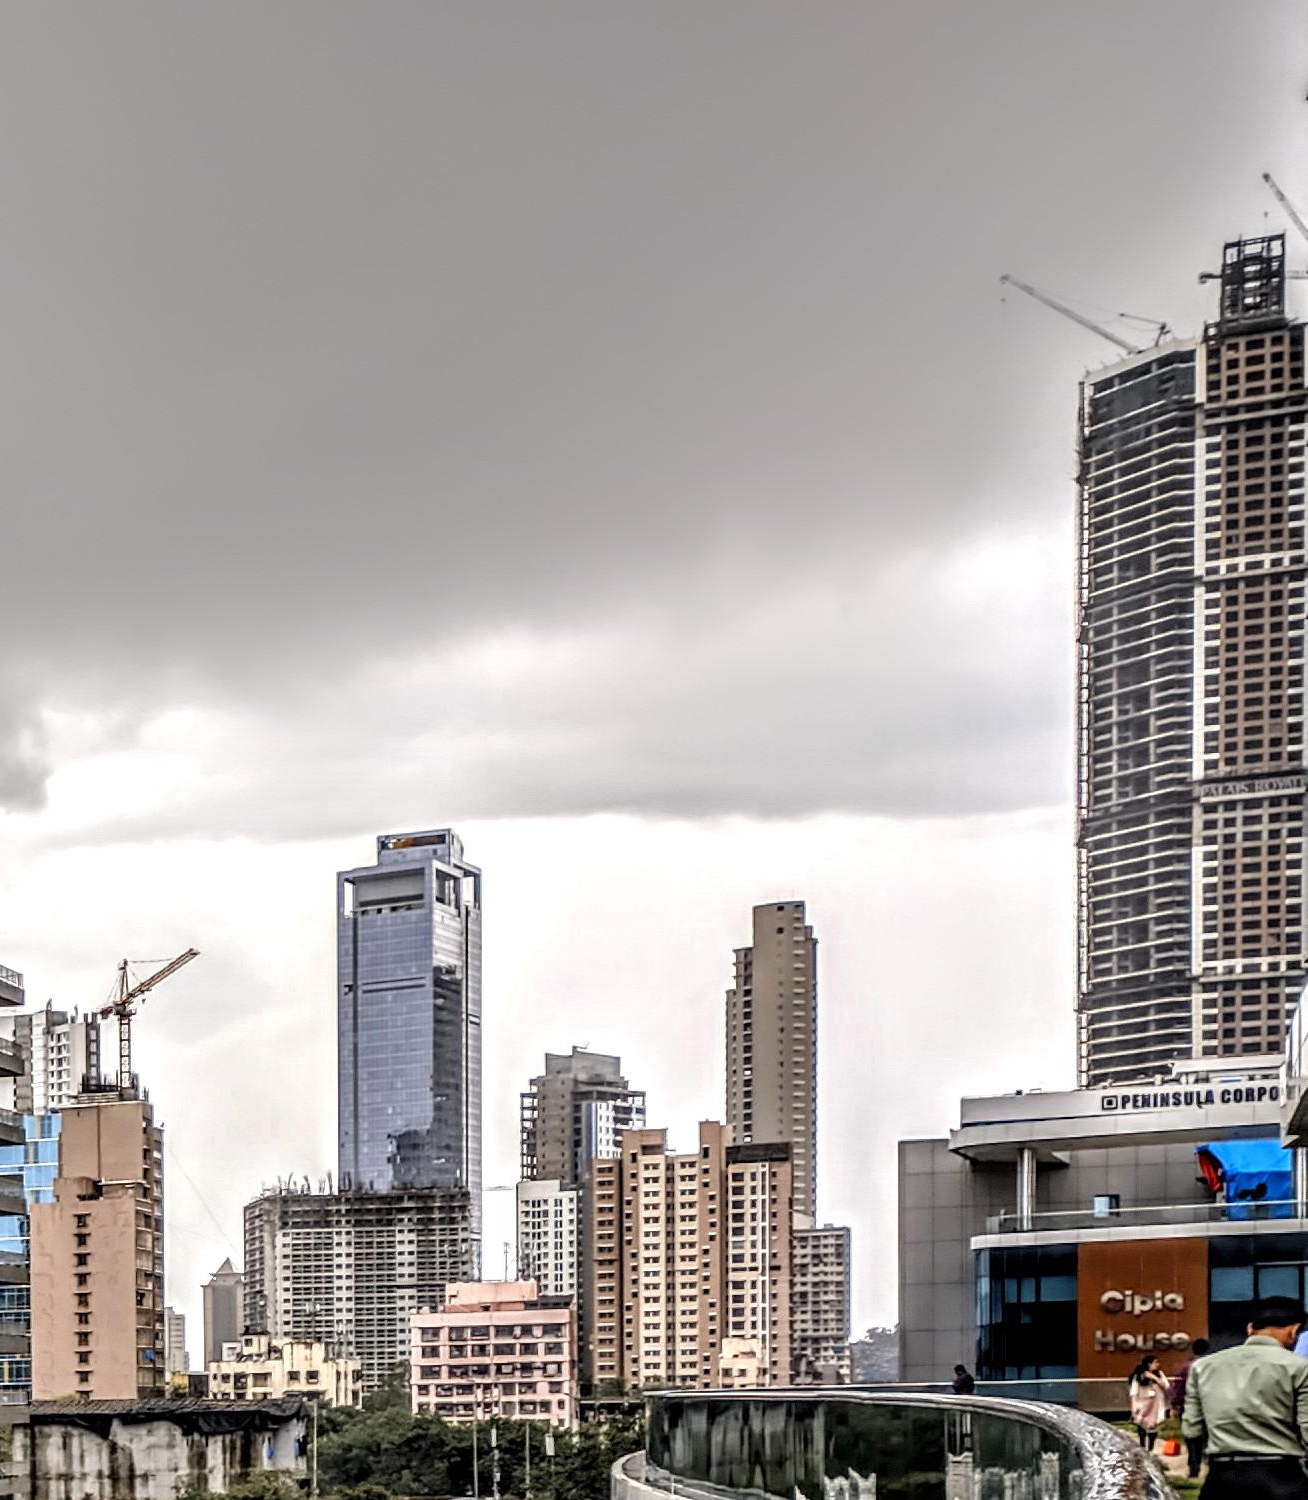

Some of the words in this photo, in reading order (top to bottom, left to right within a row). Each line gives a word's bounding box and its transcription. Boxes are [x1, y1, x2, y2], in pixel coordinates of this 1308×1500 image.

[1121, 1089, 1215, 1109] PENINSULA
[1100, 1289, 1185, 1315] Cipla
[1094, 1330, 1190, 1352] House
